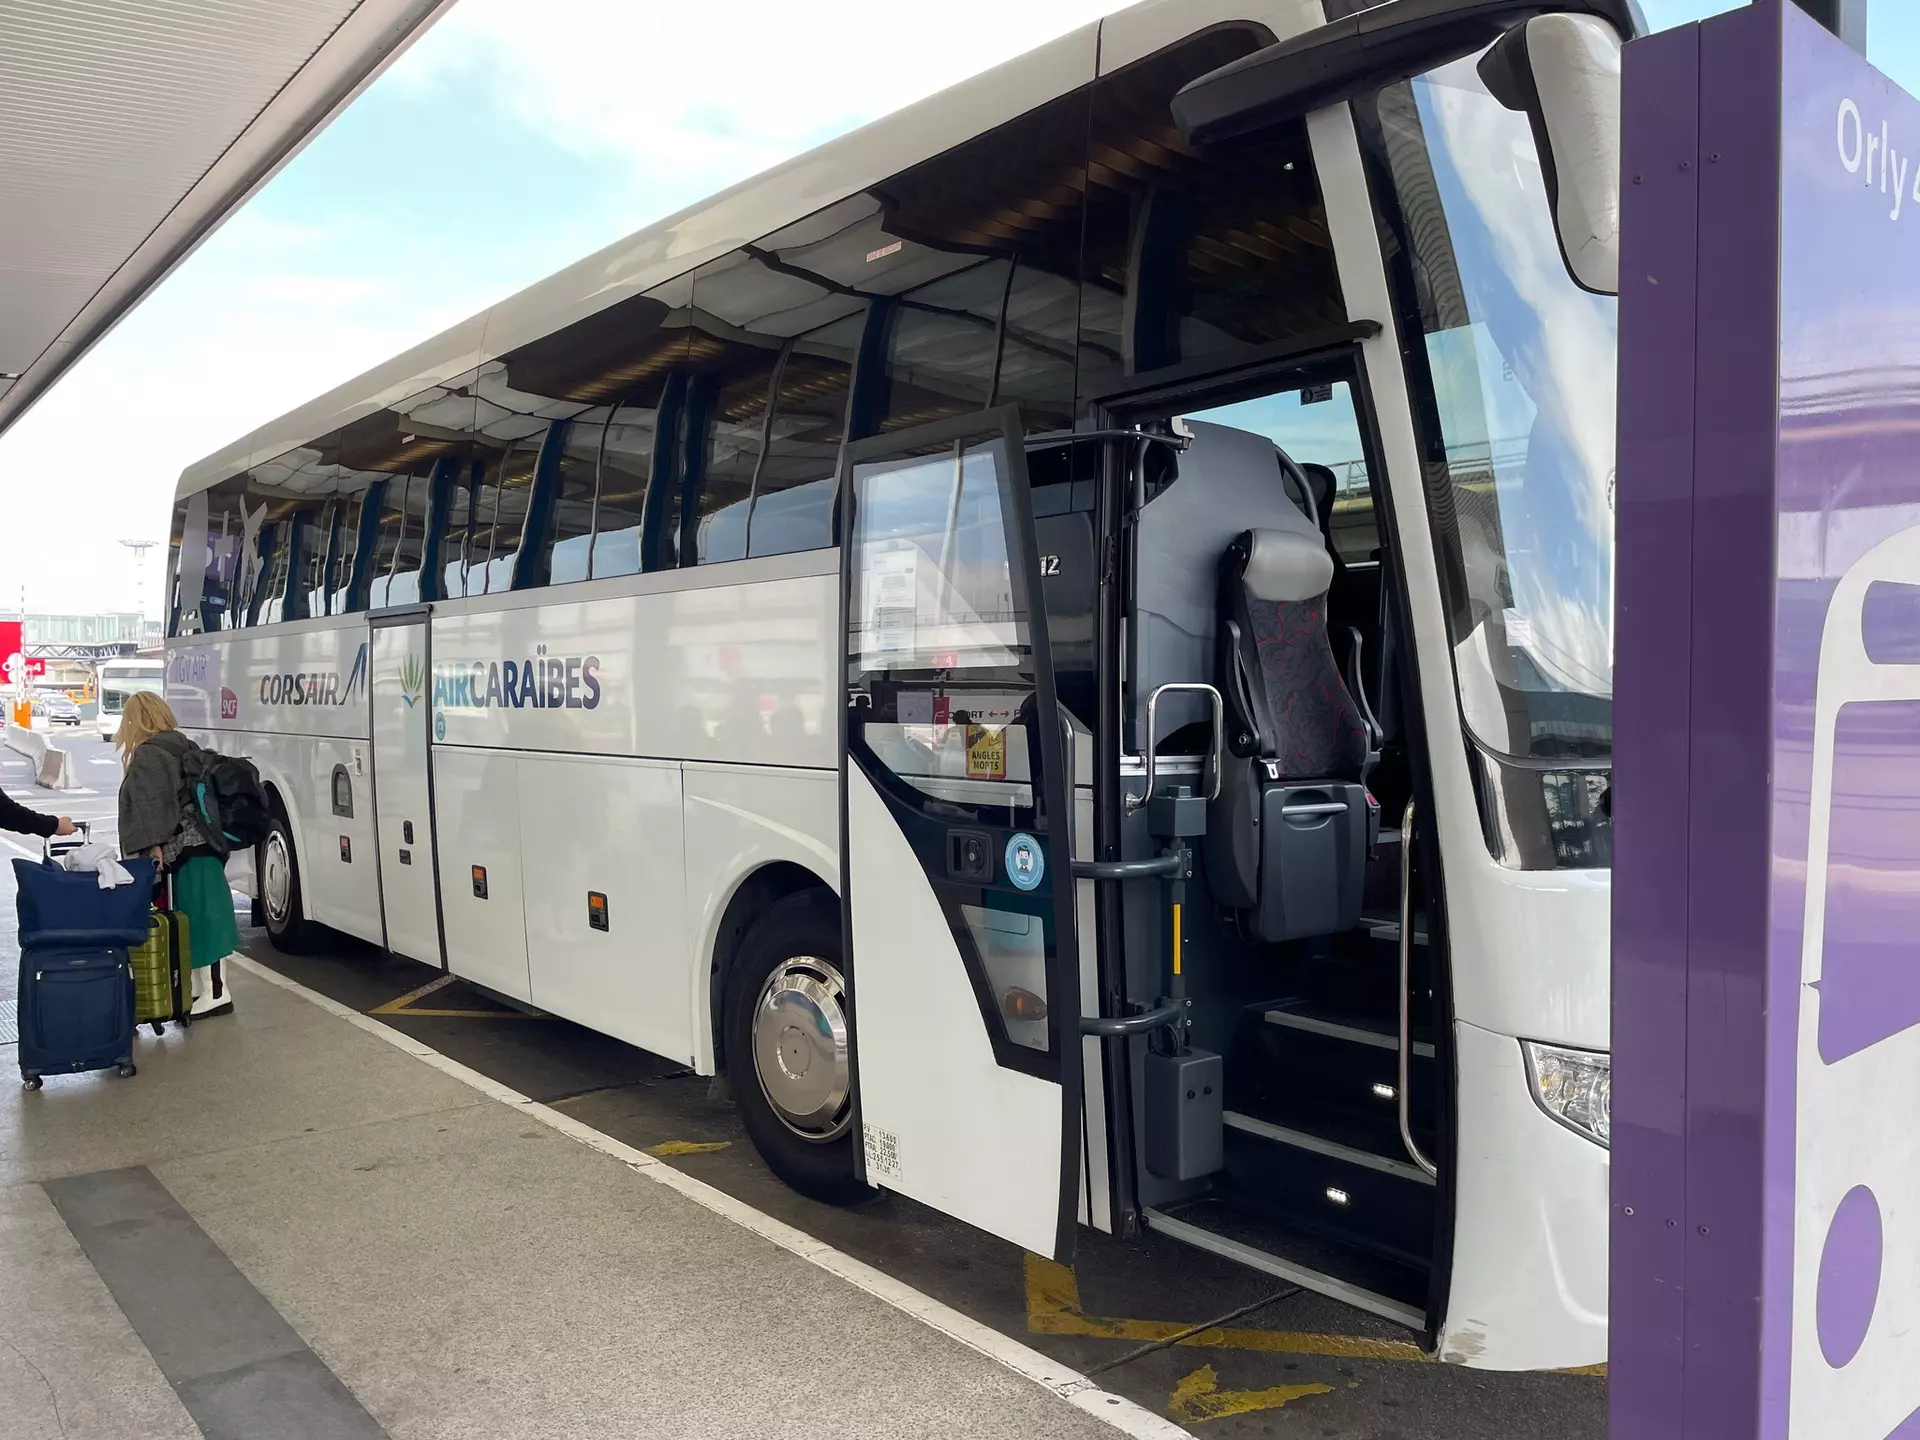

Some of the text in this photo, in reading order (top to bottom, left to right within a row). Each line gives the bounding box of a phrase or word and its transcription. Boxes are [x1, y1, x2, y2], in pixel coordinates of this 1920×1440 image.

[1837, 97, 1908, 221] Orly
[1040, 555, 1060, 577] 12
[260, 672, 340, 706] CORSAIR
[971, 751, 1000, 760] ANGLES
[973, 760, 999, 770] MORTS
